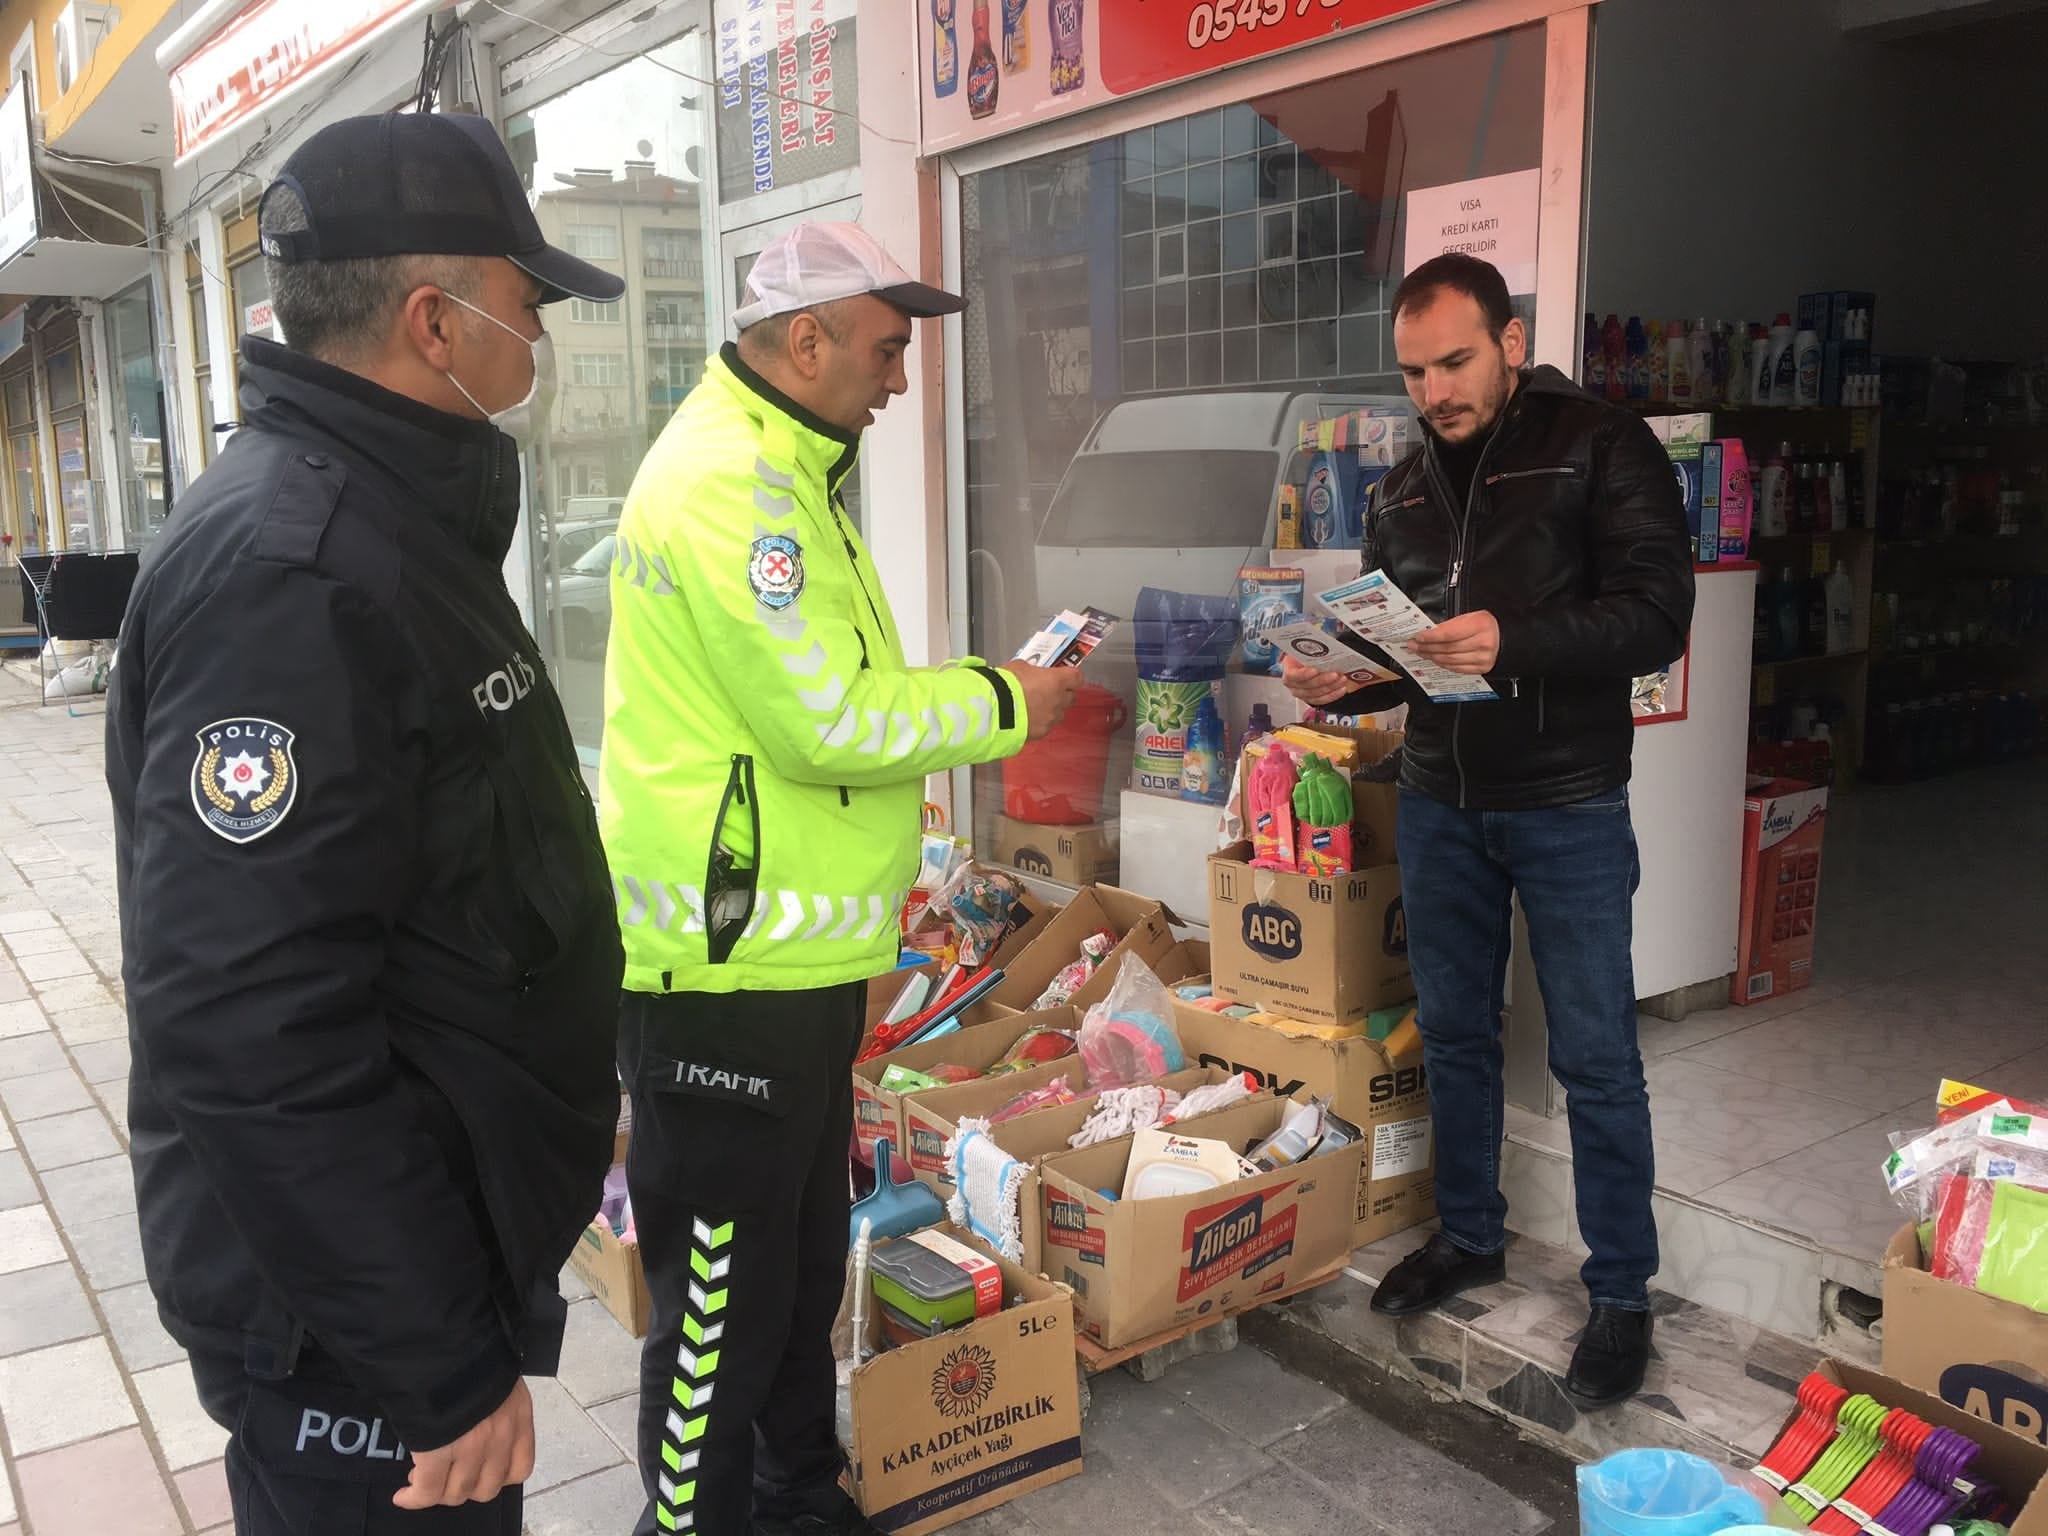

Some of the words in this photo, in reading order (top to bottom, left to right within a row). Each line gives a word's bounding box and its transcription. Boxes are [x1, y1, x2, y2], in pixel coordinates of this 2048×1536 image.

[750, 54, 773, 192] PERAKENDE
[1460, 199, 1481, 211] VISA
[209, 725, 283, 746] POLİS
[1249, 913, 1297, 949] ABC
[1239, 972, 1260, 983] ULTRA
[1291, 982, 1310, 995] SUYU
[1163, 1145, 1200, 1157] ZAMBAK
[1195, 1210, 1257, 1267] Ailem
[1184, 1272, 1203, 1289] SIVI
[296, 1407, 406, 1461] POL
[882, 1394, 1055, 1474] KARADENİZBİRLİK
[1962, 1387, 2048, 1447] AB
[930, 1446, 982, 1477] Ayçiçek
[985, 1433, 1014, 1459] Yağı
[917, 1477, 975, 1512] Kooperatif
